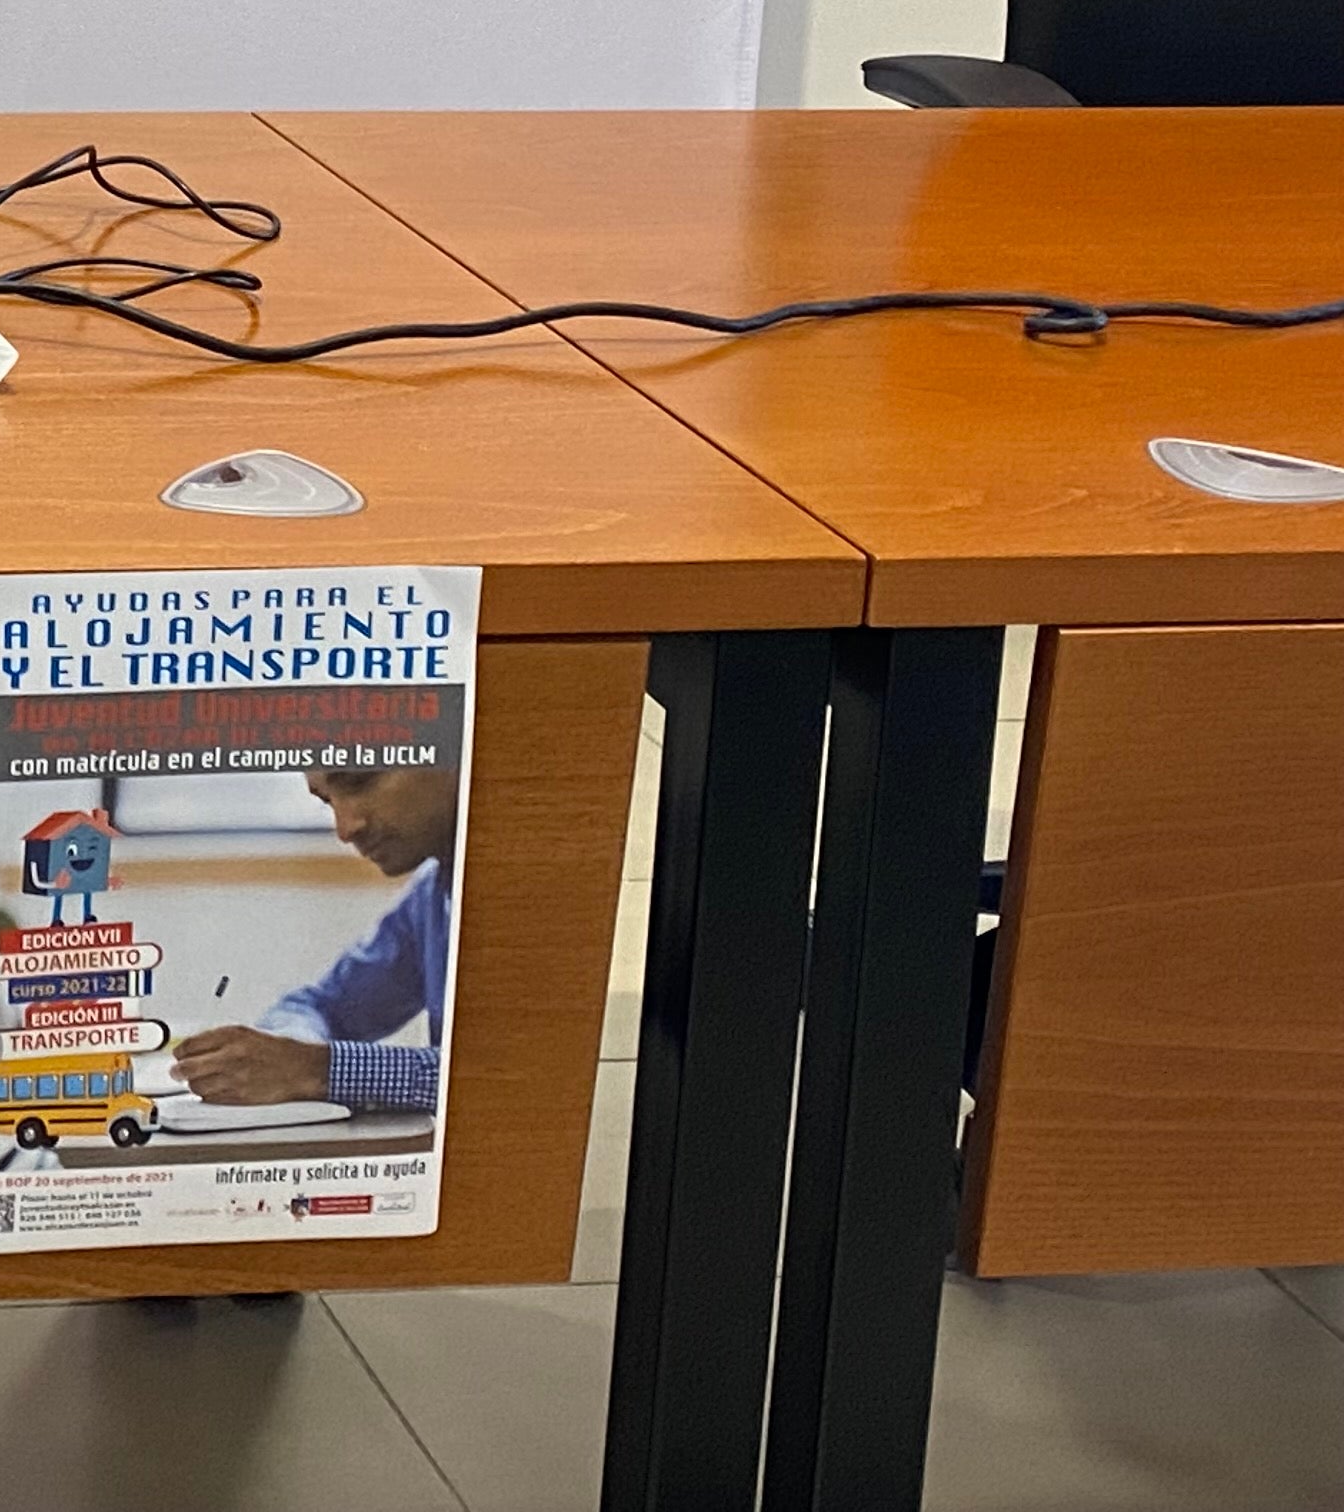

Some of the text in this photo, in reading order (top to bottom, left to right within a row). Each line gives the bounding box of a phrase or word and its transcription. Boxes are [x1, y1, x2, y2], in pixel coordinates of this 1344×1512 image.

[32, 585, 423, 613] AYUDAS PARA EL
[4, 609, 451, 647] ALOJAMIENTO
[2, 644, 448, 689] Y EL TRANSPORTE
[11, 745, 435, 776] con matrícula en el campus de la UCLM
[22, 928, 120, 949] EDICIÓN VII
[1, 950, 140, 971] ALOJAMIENTO
[31, 1006, 118, 1027] EDICIÓN III
[10, 1029, 139, 1049] TRANSPORTE
[215, 1158, 427, 1186] infórmate y solicita tu ayuda
